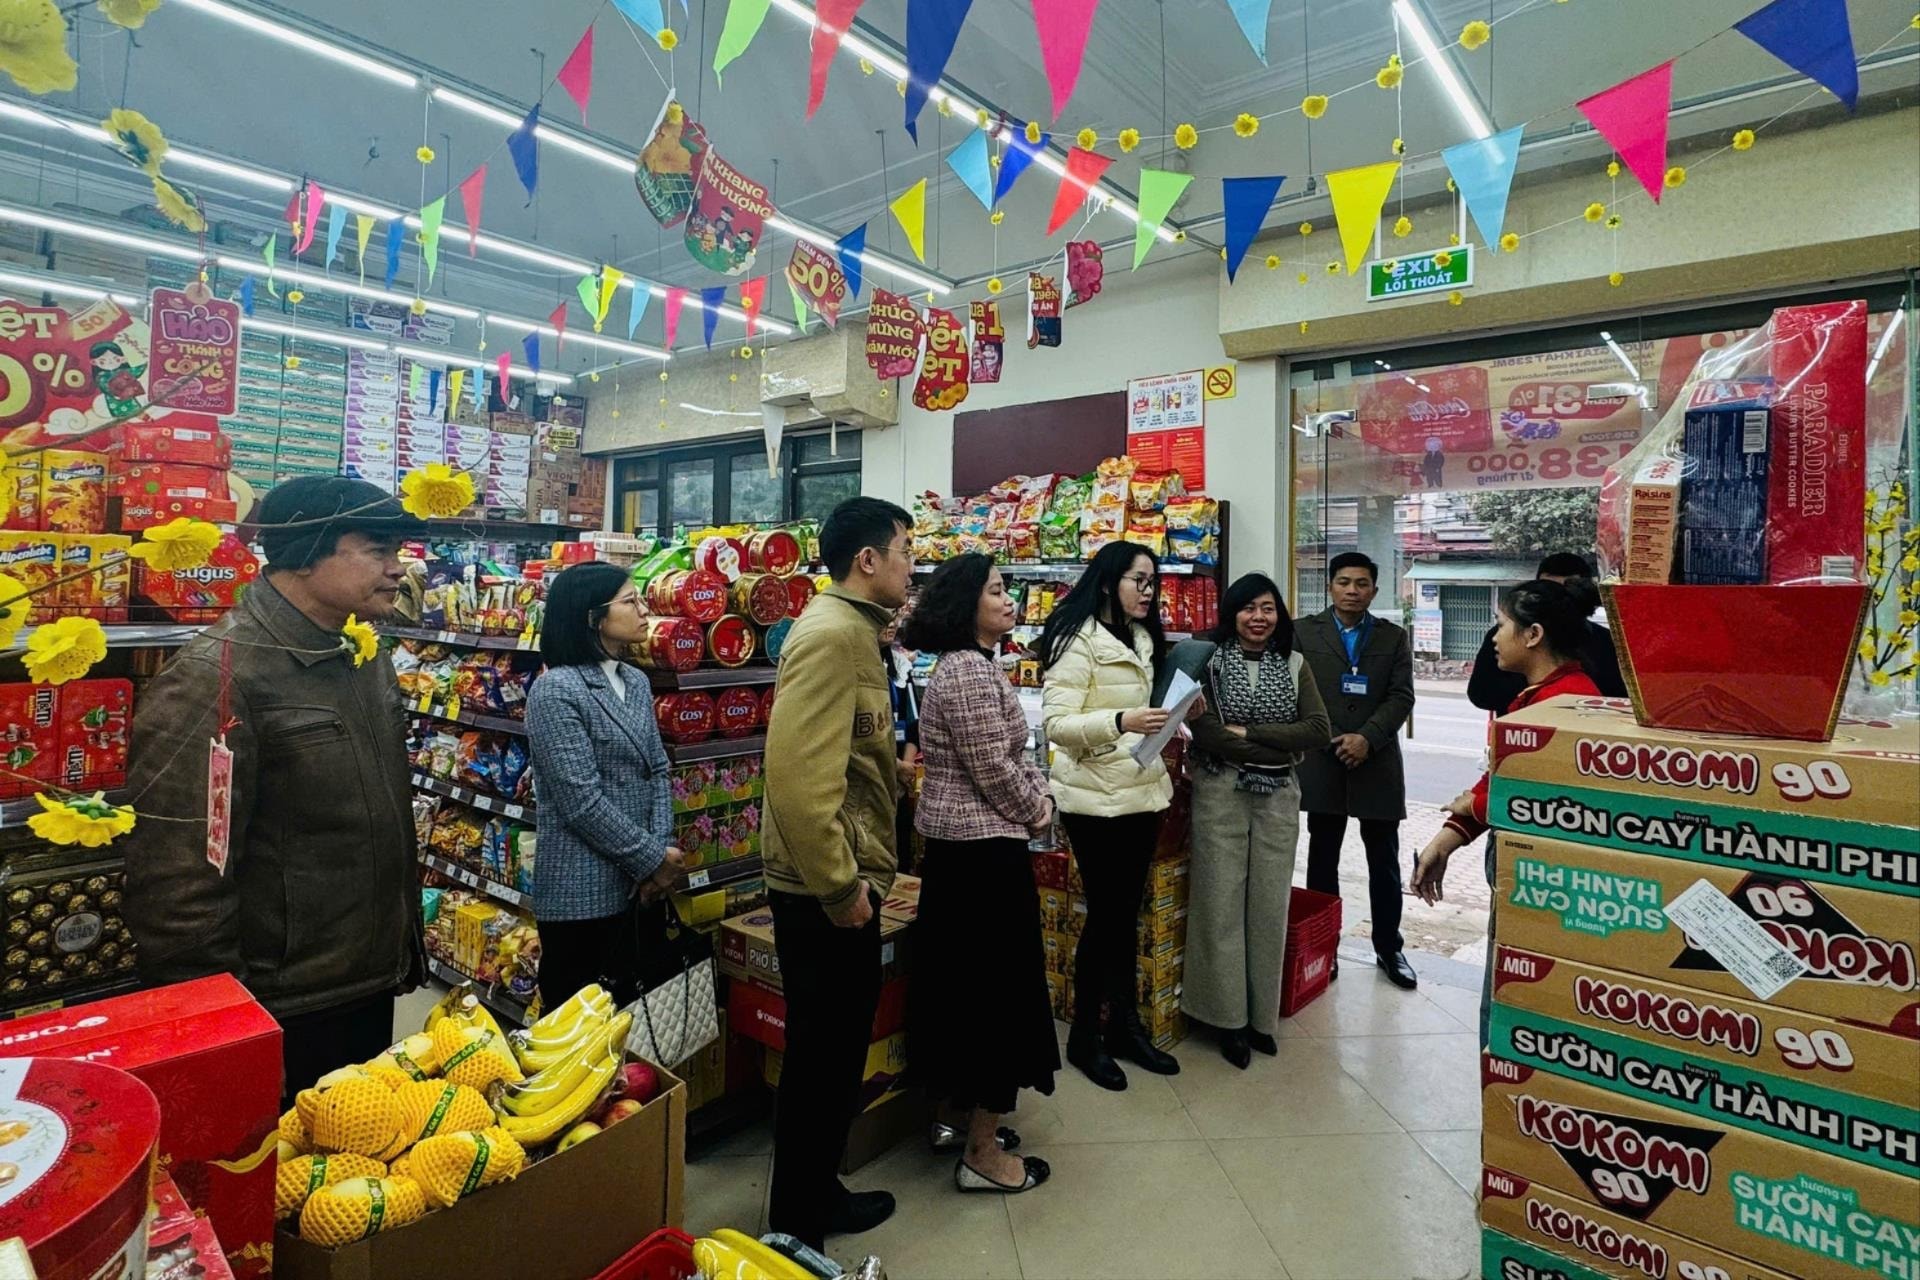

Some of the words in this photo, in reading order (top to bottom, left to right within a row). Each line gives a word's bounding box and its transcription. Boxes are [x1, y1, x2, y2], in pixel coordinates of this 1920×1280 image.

[790, 252, 847, 299] 50%
[1409, 271, 1453, 288] THOÁT
[1788, 431, 1798, 466] BUTTER
[1801, 382, 1828, 517] PARADIER
[1634, 488, 1673, 501] Raisins
[1787, 468, 1798, 508] COOKIES
[173, 565, 235, 584] sugus
[692, 589, 717, 601] COSY
[675, 638, 697, 650] COSY
[679, 710, 704, 722] COSY
[726, 705, 750, 717] COSY
[1505, 727, 1539, 748] MỚI
[1575, 738, 1760, 795] KOKOMI
[1771, 760, 1853, 802] 90
[1510, 797, 1608, 836] SƯỜN
[1616, 814, 1694, 848] CAY
[1705, 822, 1829, 870] HÀNH
[1840, 847, 1920, 883] PHI
[1518, 860, 1564, 888] PHI
[1571, 869, 1658, 905] HÀNH
[1513, 883, 1571, 912] CAY
[1577, 895, 1665, 931] SƯỜN
[1746, 883, 1815, 918] 90
[1503, 956, 1537, 979] MỚI
[1575, 974, 1761, 1056] KOKOMI
[1773, 1027, 1856, 1071] 90
[1489, 1057, 1519, 1082] MỚI
[1514, 1028, 1615, 1077] SƯỜN
[1624, 1061, 1703, 1101] CAY
[1714, 1084, 1840, 1141] HÀNH
[1517, 1094, 1711, 1195] KOKOMI
[1487, 1173, 1515, 1197] MỚI
[1590, 1168, 1650, 1206] 90
[1800, 1177, 1840, 1200] hương
[1733, 1175, 1837, 1228] SƯỜN
[1846, 1212, 1920, 1255] CAY
[1525, 1199, 1669, 1280] KOKOMI
[1740, 1203, 1845, 1259] HÀNH
[1855, 1240, 1920, 1280] PHI
